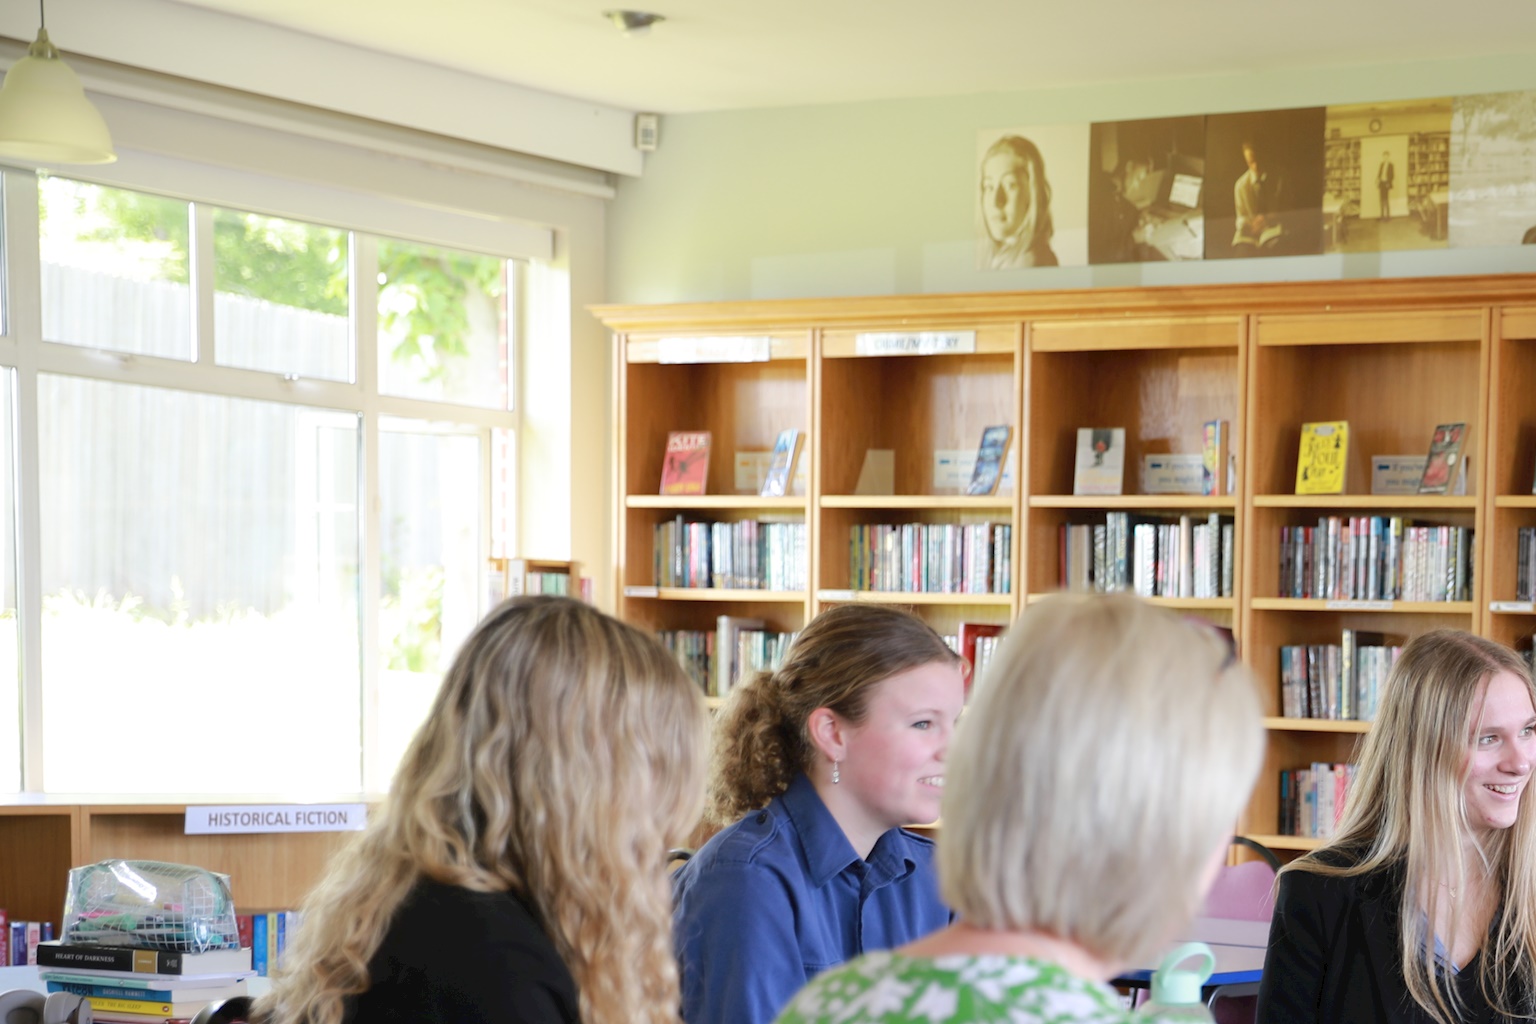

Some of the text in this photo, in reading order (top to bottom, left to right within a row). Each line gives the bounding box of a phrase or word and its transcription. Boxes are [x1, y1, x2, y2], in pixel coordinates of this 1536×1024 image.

[208, 811, 348, 827] HISTORICAL FICTION
[55, 952, 75, 960] HEART
[83, 954, 115, 963] DARKNESS
